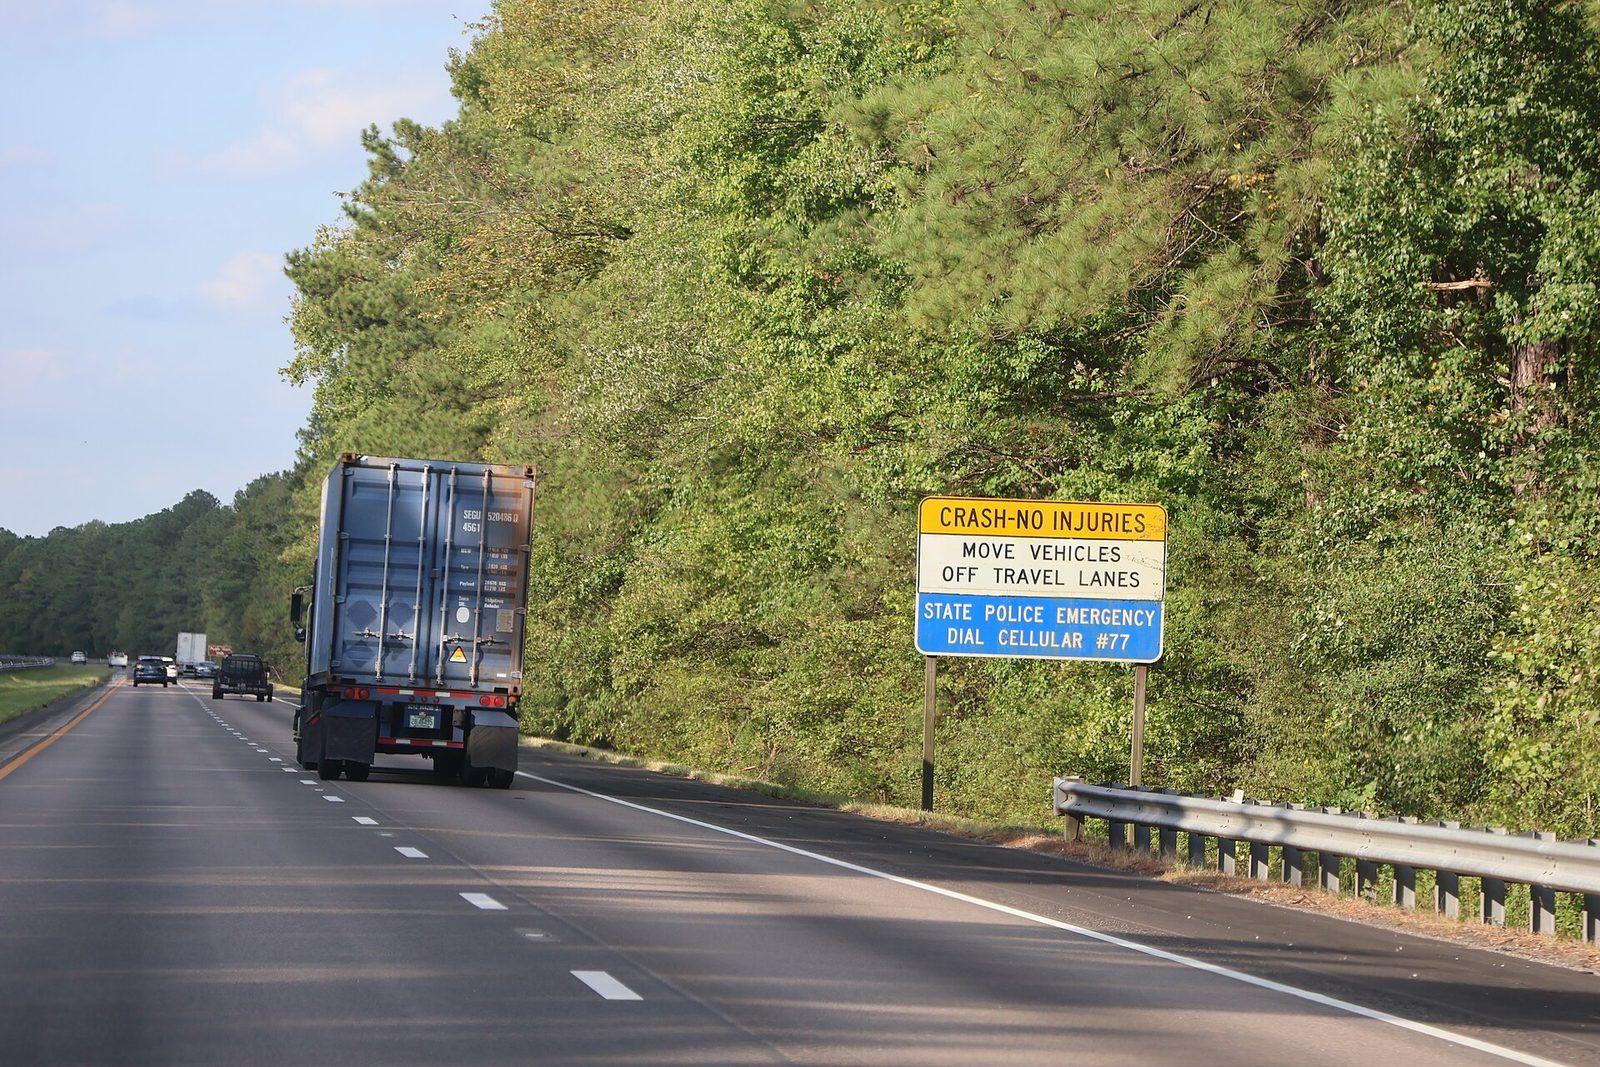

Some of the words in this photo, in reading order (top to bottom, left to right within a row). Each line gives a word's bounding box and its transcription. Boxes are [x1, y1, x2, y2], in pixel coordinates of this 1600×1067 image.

[463, 510, 481, 519] SEGU
[940, 506, 1044, 530] CRASH-NO
[1053, 510, 1146, 533] INJURIES
[462, 523, 480, 532] 45G1
[962, 541, 1015, 560] MOVE
[1030, 544, 1121, 563] VEHICLES
[942, 565, 979, 582] OFF
[993, 568, 1064, 586] TRAVEL
[1079, 570, 1140, 588] LANES
[924, 602, 972, 621] STATE
[985, 604, 1044, 623] POLICE
[1056, 607, 1155, 627] EMERGENCY
[947, 627, 984, 645] DIAL
[998, 629, 1083, 649] CELLULAR
[1096, 633, 1130, 650] #77
